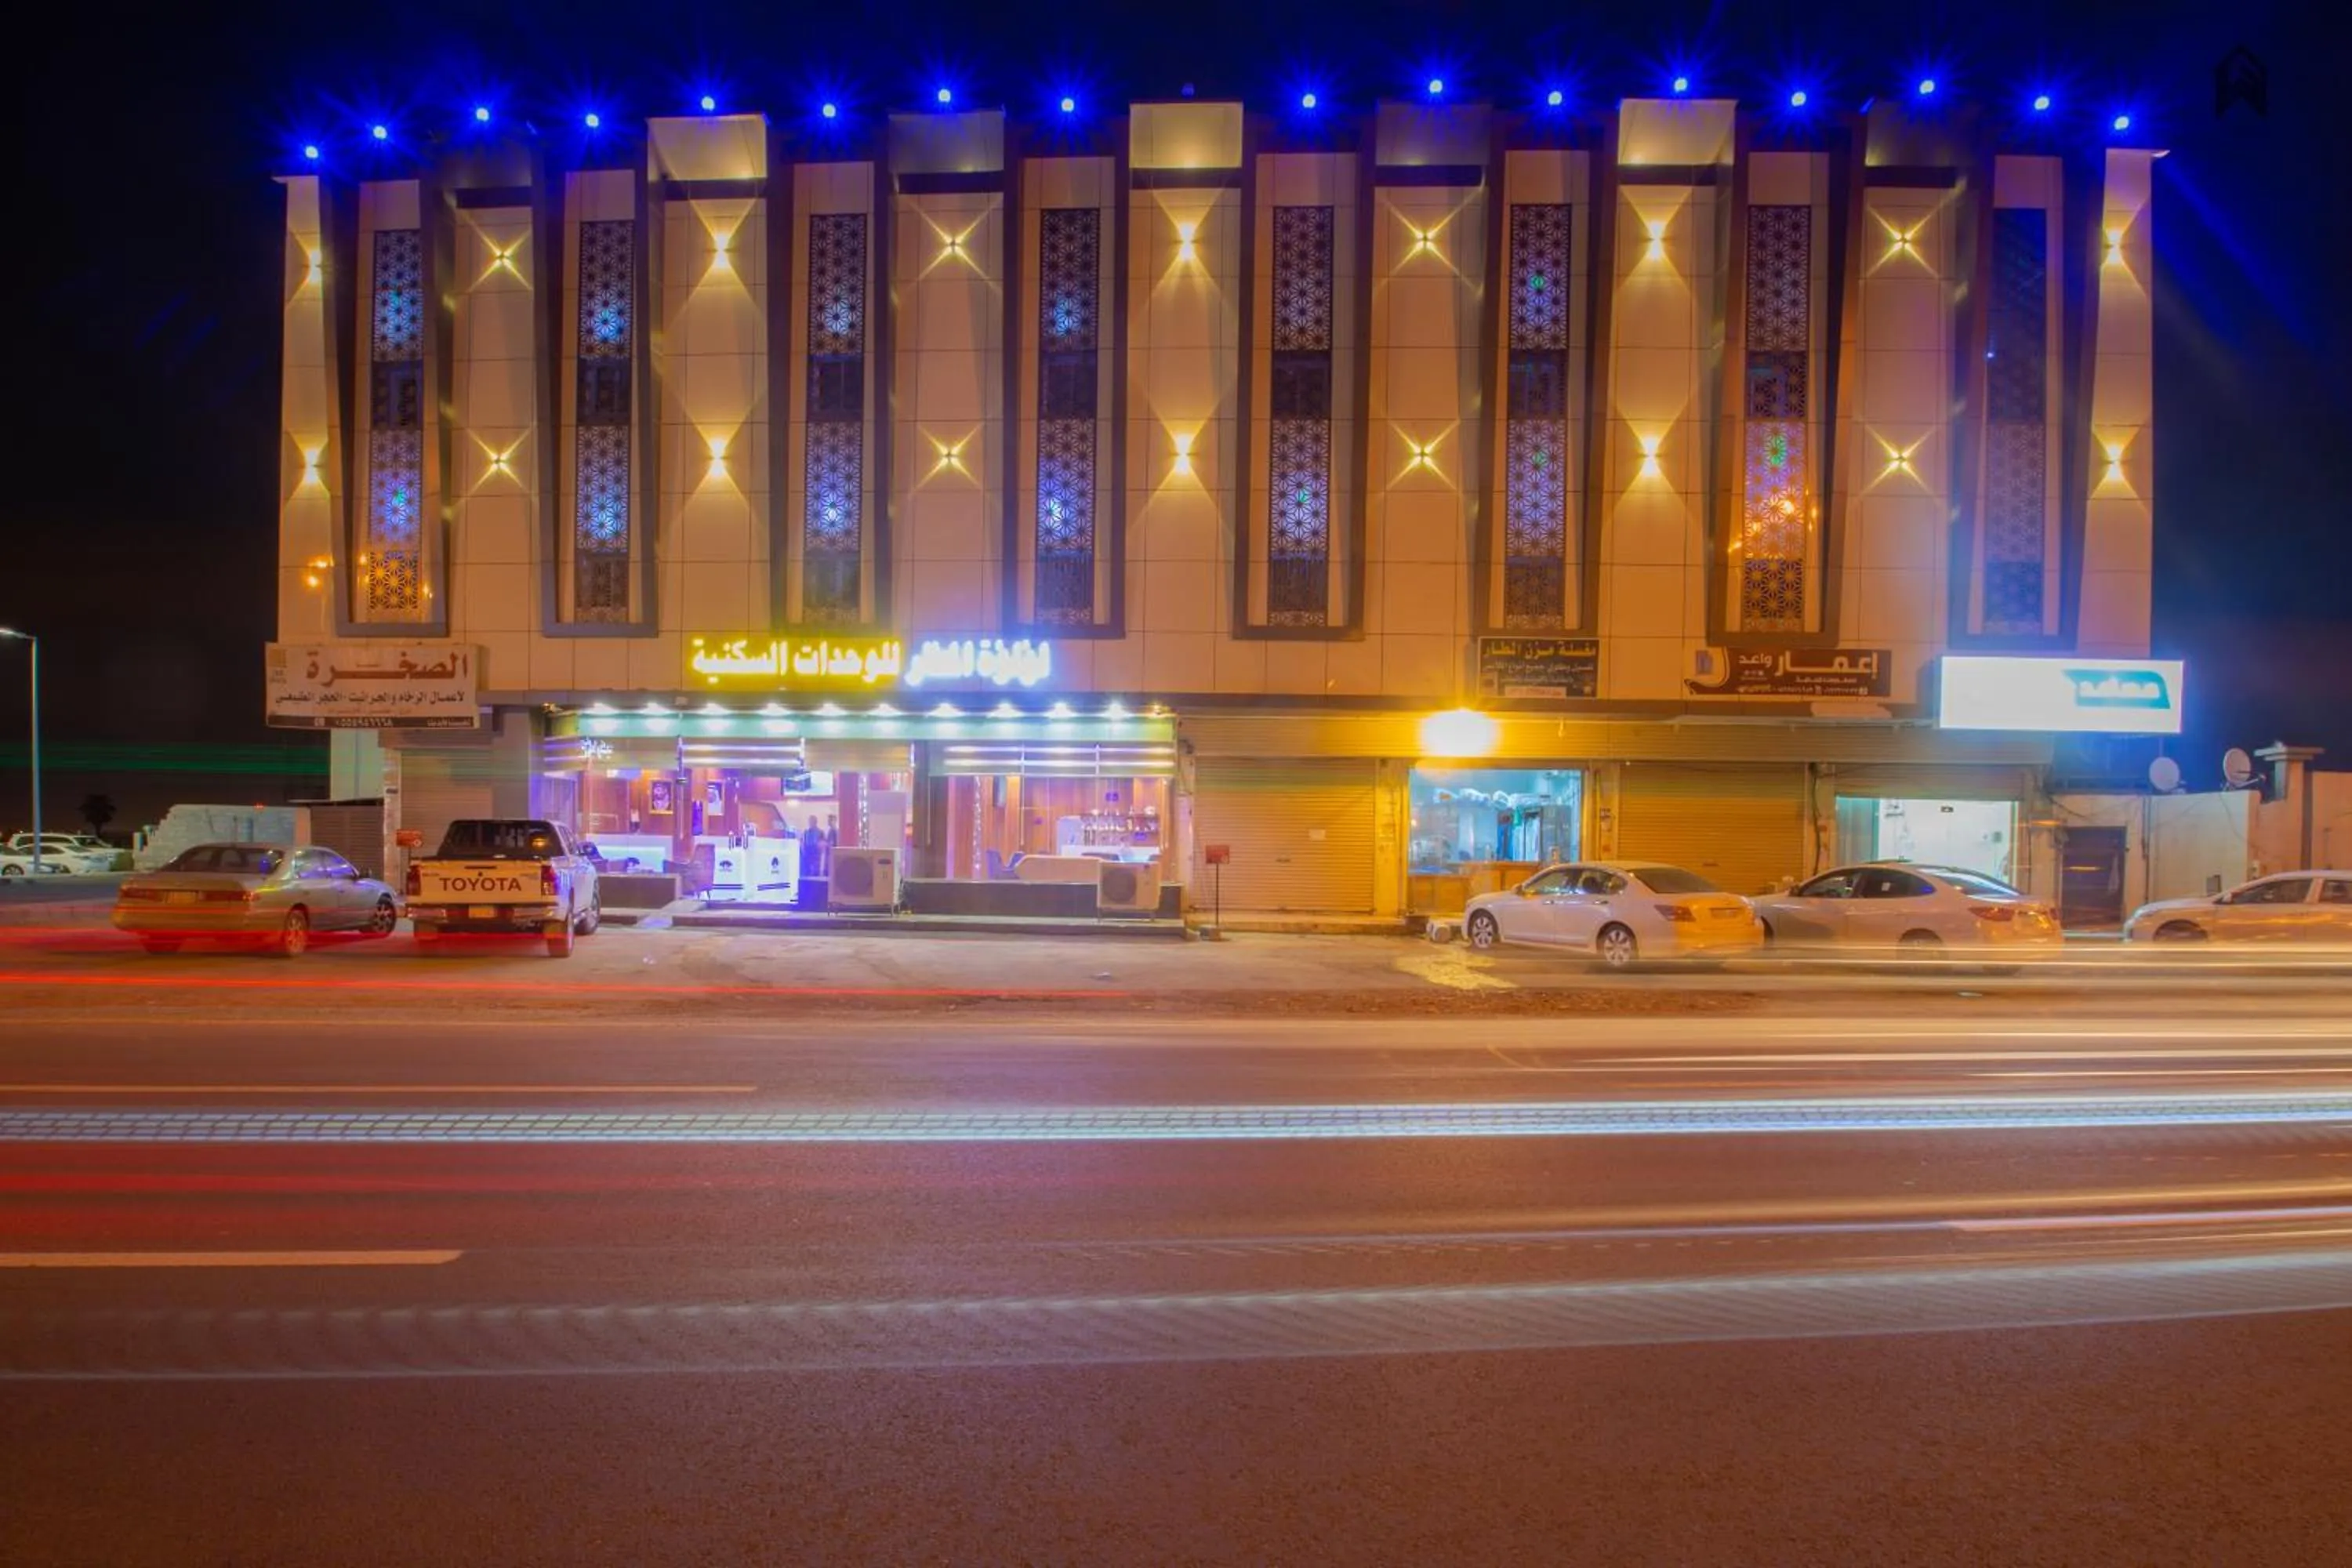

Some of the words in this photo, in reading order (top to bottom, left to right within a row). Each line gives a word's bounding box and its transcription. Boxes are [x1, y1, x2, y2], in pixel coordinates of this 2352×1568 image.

[307, 650, 468, 688] الصخرة
[691, 638, 788, 684] السكنية
[793, 640, 901, 683] للوحدات
[439, 877, 522, 892] TOYOTA
